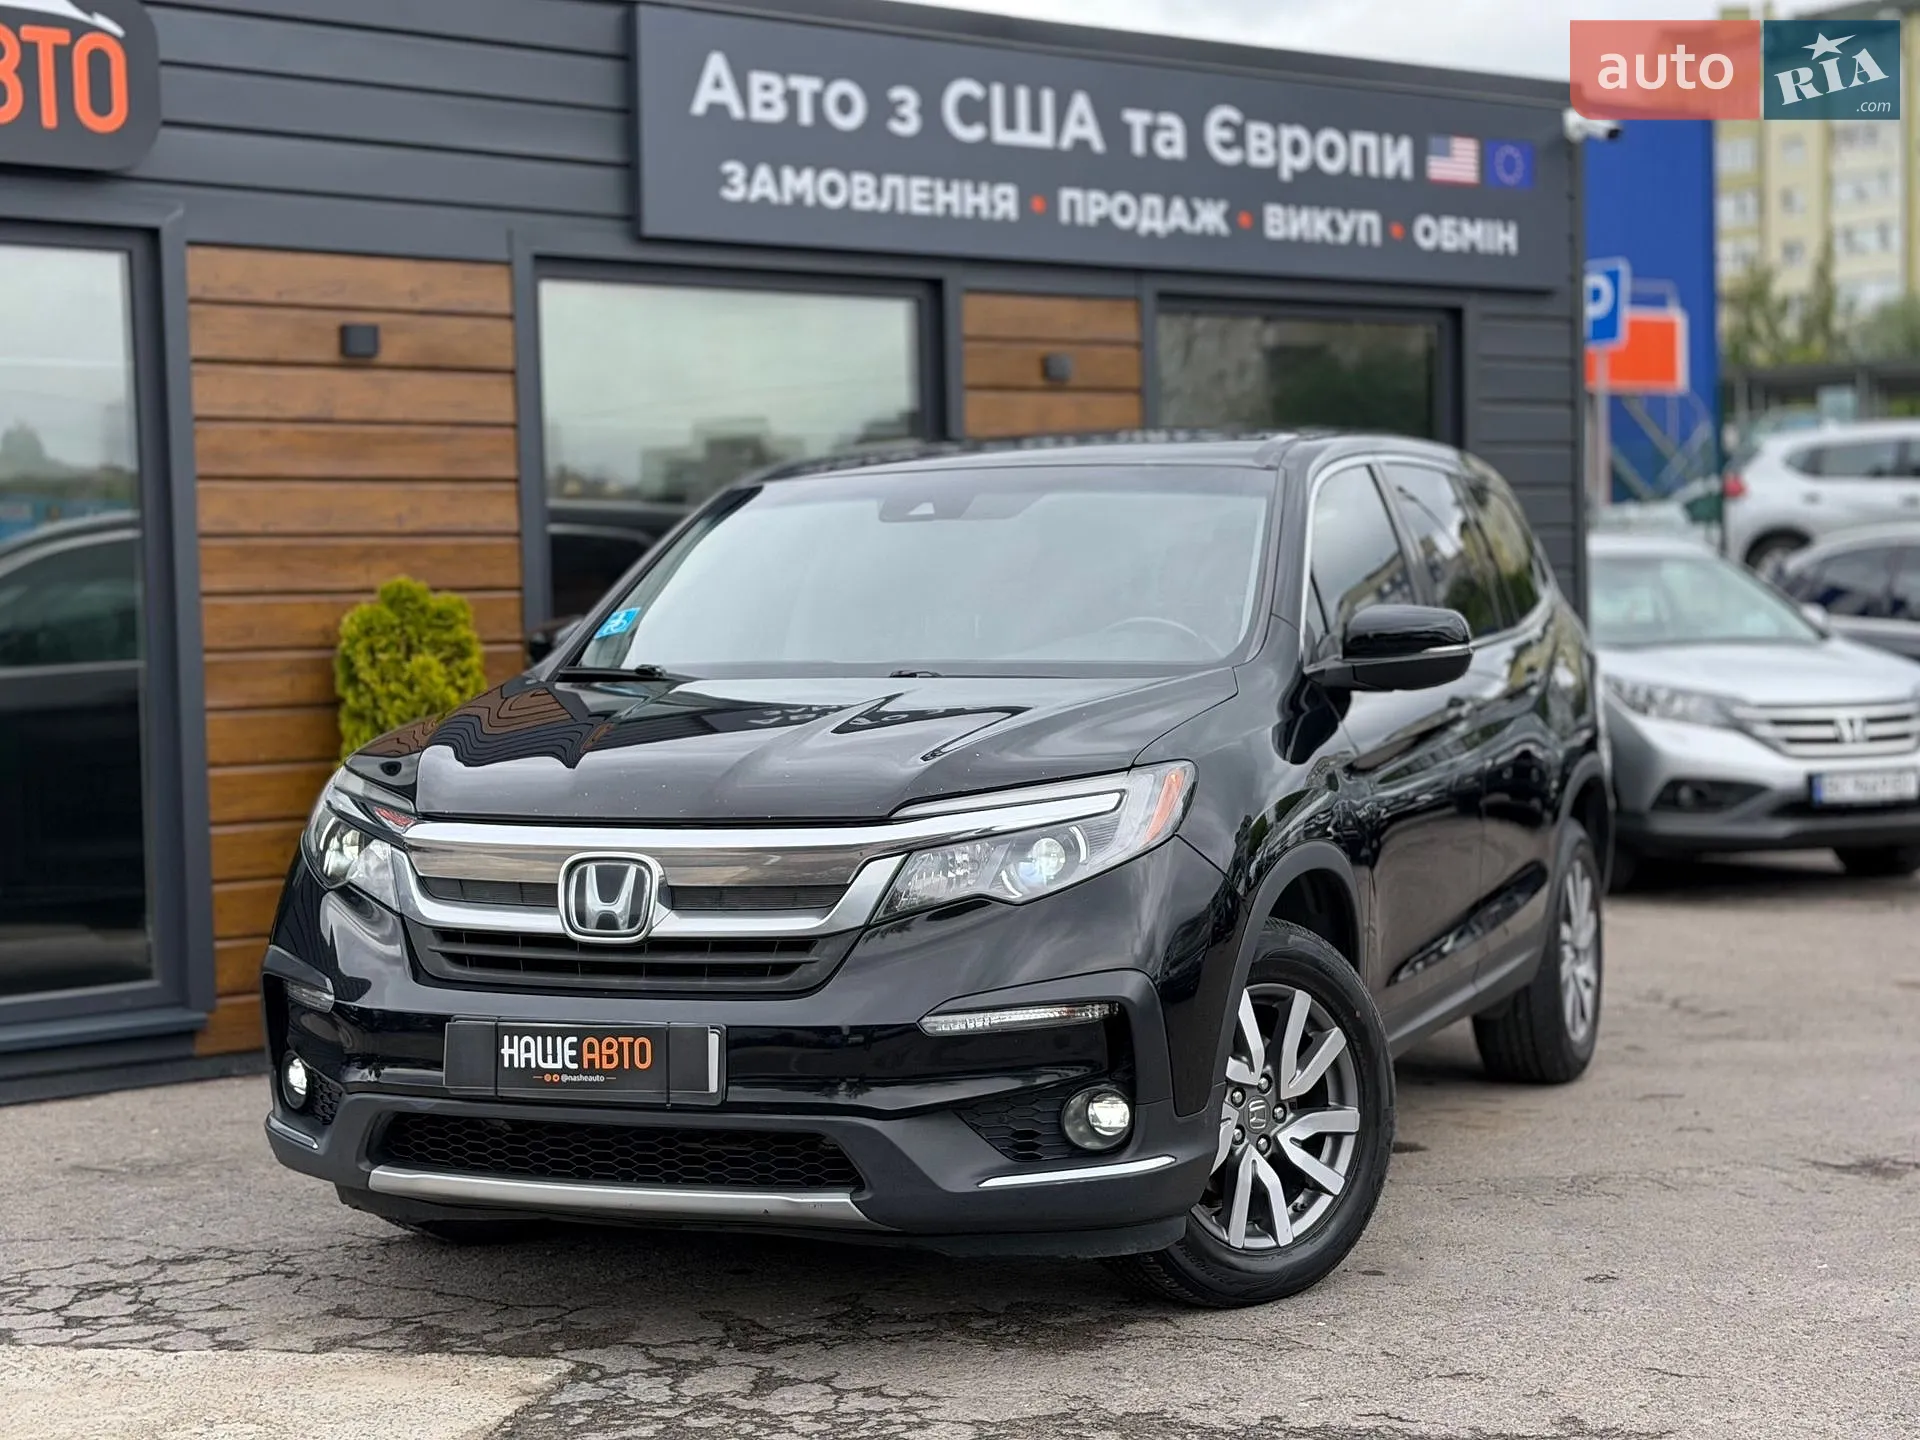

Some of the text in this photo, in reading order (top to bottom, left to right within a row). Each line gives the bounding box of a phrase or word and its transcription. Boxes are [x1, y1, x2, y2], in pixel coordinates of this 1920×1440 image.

[689, 50, 1413, 182] Авто з США та Європи
[719, 160, 1518, 255] ЗАМОВЛЕННЯ ПРОДАЖ ВИКУП ОБМІН
[501, 1035, 652, 1070] НАШЕ АВТО
[561, 1074, 605, 1082] @nasheauto
